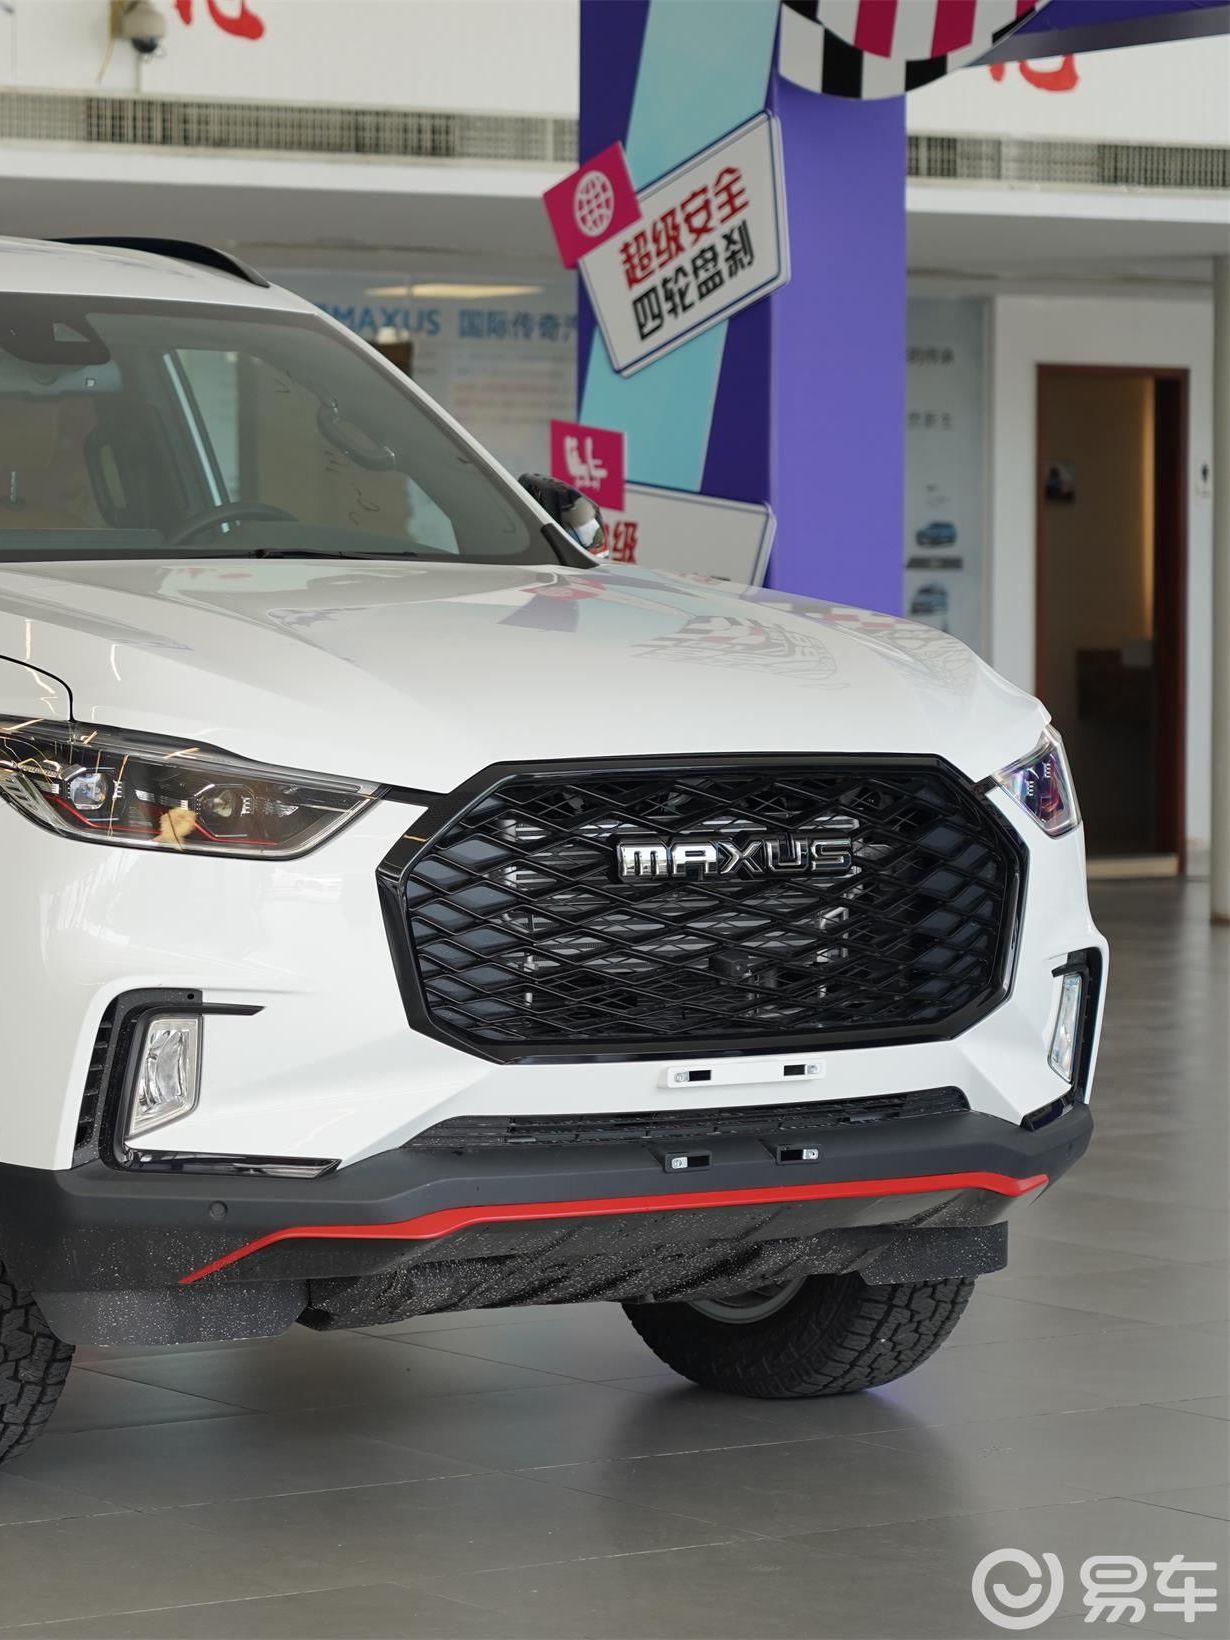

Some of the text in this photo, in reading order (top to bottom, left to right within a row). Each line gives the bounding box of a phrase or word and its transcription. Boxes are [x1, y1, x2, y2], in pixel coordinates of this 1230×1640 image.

[619, 166, 751, 291] 超级安全
[632, 219, 755, 342] 四轮盘刹
[604, 521, 639, 564] 级
[618, 838, 853, 881] MAXUS
